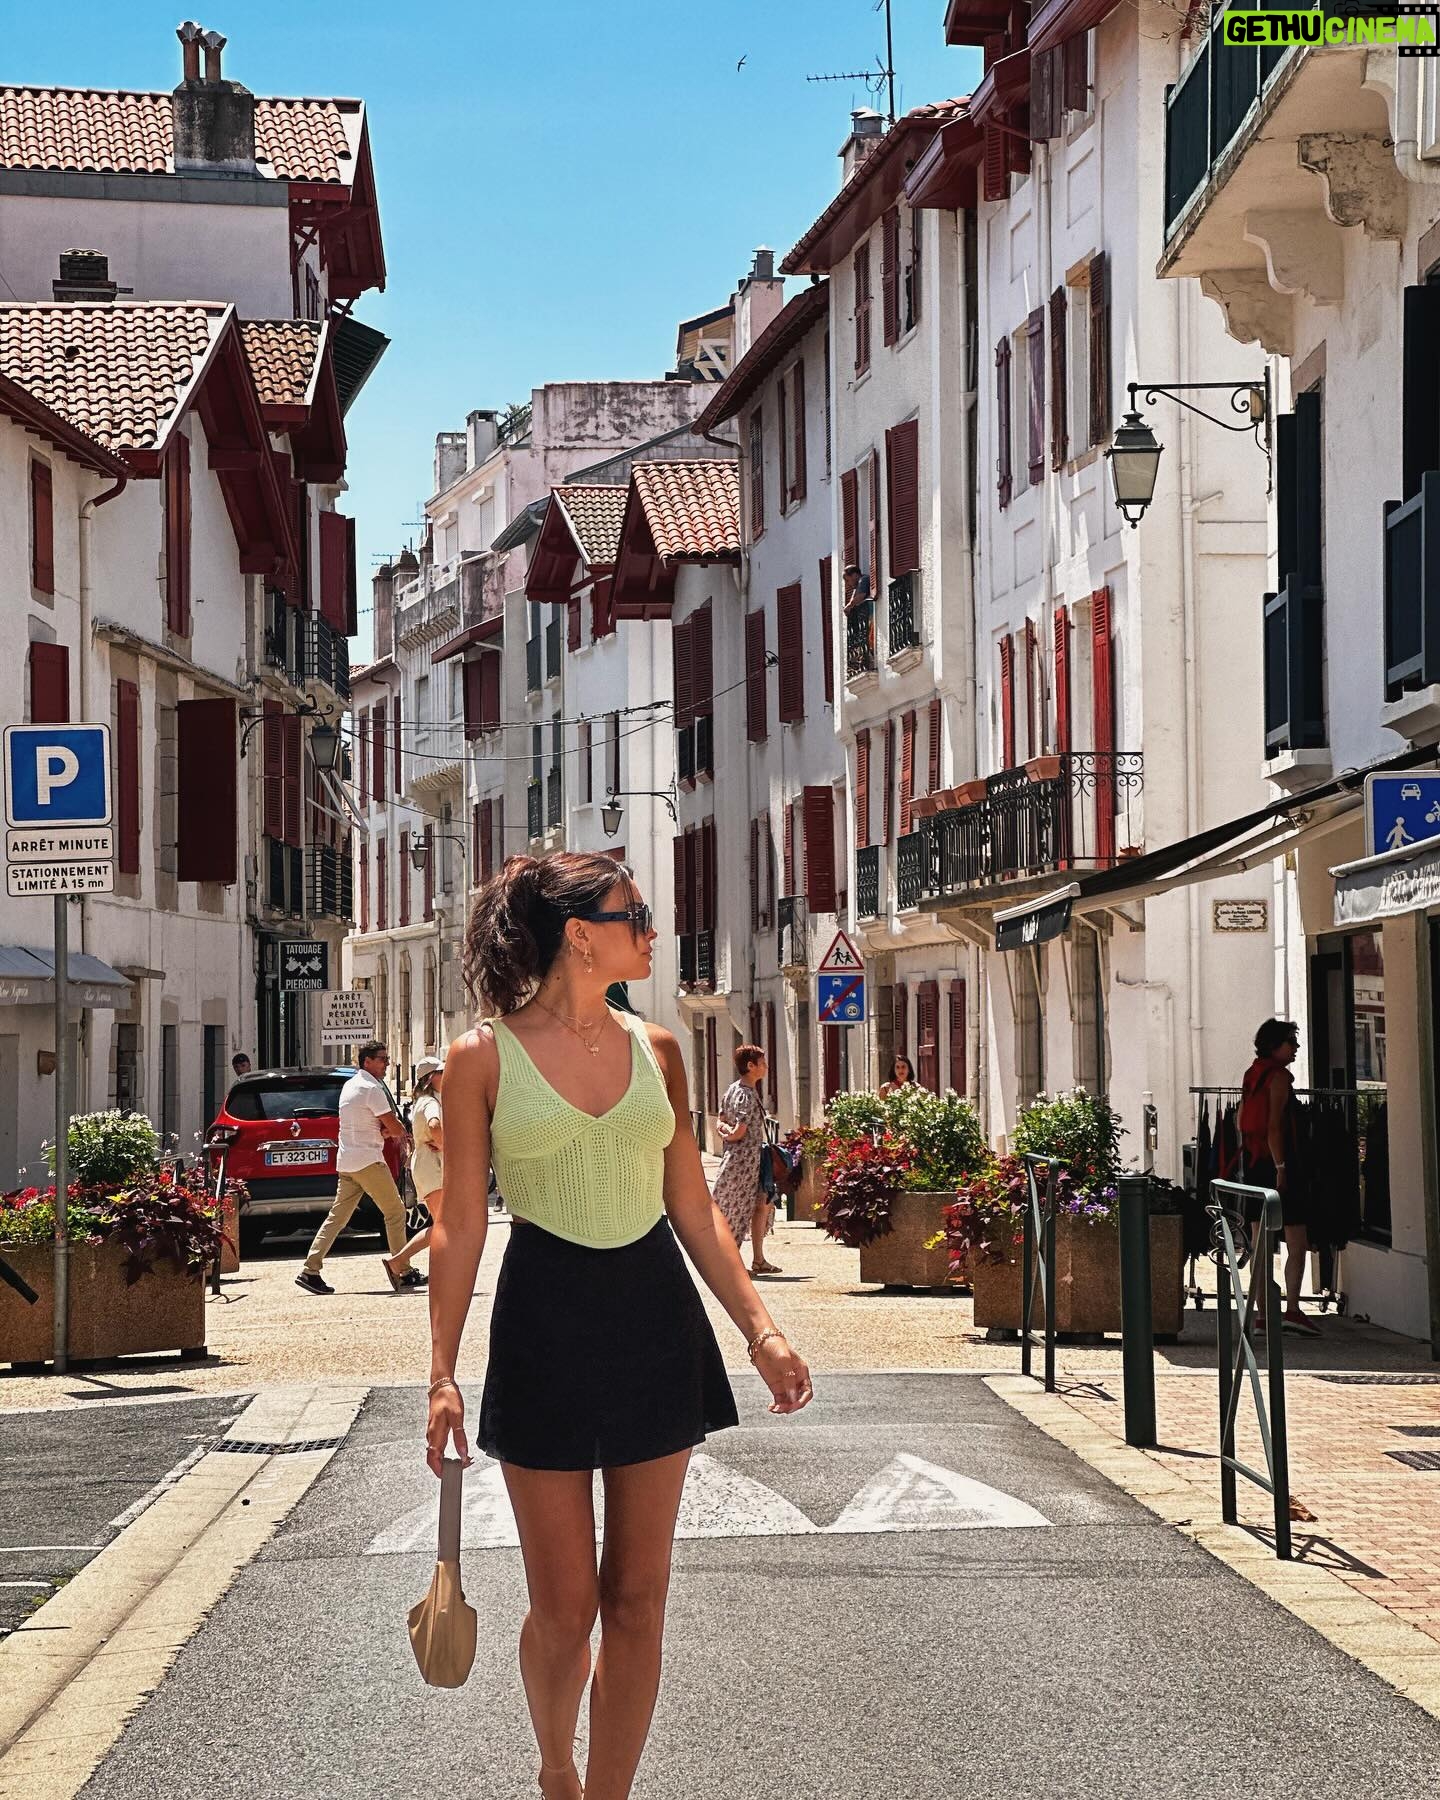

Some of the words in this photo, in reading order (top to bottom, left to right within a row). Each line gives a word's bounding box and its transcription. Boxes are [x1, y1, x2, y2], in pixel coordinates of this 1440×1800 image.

[36, 746, 80, 805] P
[12, 839, 55, 852] ARRÊT
[59, 838, 109, 851] MINUTE
[12, 865, 109, 879] STATIONNEMENT
[17, 877, 57, 891] LIMITÉ
[61, 877, 68, 889] À
[71, 878, 84, 889] 15
[88, 880, 104, 888] mn
[286, 944, 322, 954] TATOUAGE
[286, 979, 322, 989] PIERCING
[334, 993, 361, 1001] ARRÊT
[329, 1009, 367, 1018] RÉSERVÉ
[335, 1018, 371, 1026] L'HÔTEL
